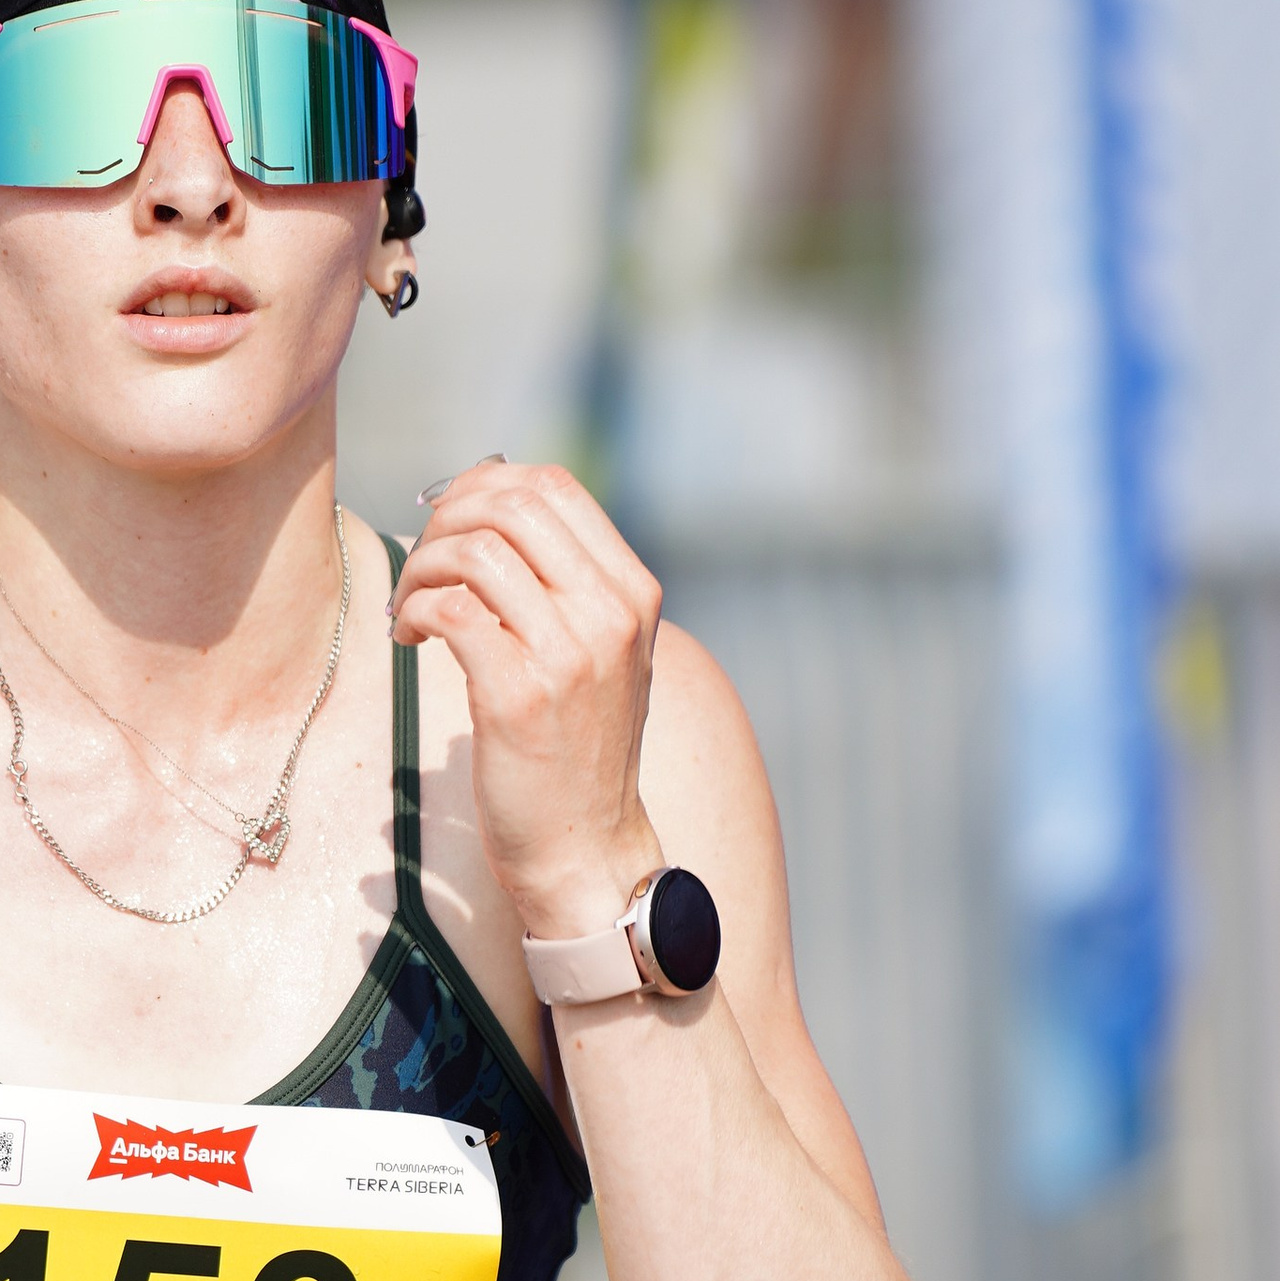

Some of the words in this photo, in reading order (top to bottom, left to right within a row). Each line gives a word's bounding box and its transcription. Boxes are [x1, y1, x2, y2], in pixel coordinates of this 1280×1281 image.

[109, 1136, 180, 1164] Альфа
[183, 1142, 237, 1164] Банк
[345, 1177, 401, 1192] TERRA
[404, 1180, 464, 1195] SIBERIA
